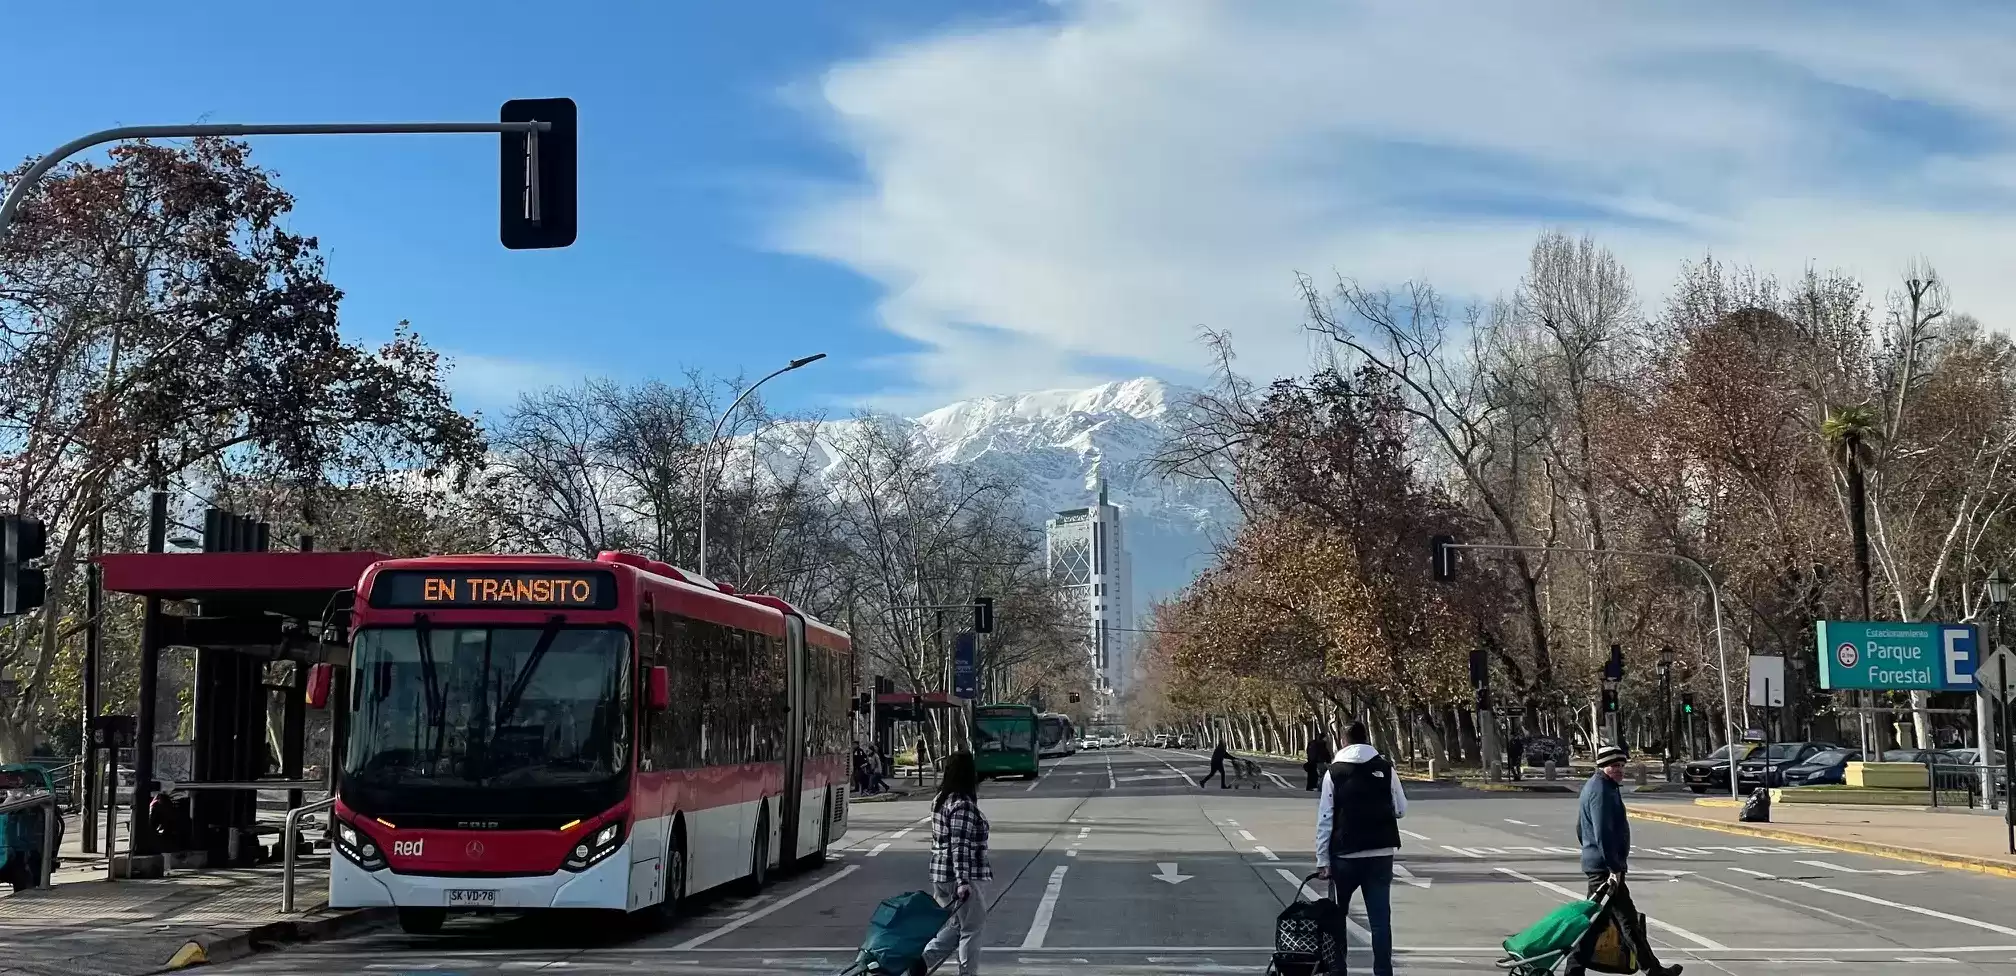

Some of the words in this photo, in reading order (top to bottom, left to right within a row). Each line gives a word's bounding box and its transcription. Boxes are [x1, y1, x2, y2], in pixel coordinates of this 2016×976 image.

[424, 578, 456, 601] EN
[467, 578, 590, 602] TRANSITO
[1866, 628, 1929, 638] Estacionamiento
[1866, 641, 1921, 664] Parque
[1943, 629, 1973, 684] E
[1868, 666, 1931, 684] Forestal
[394, 837, 424, 856] Red
